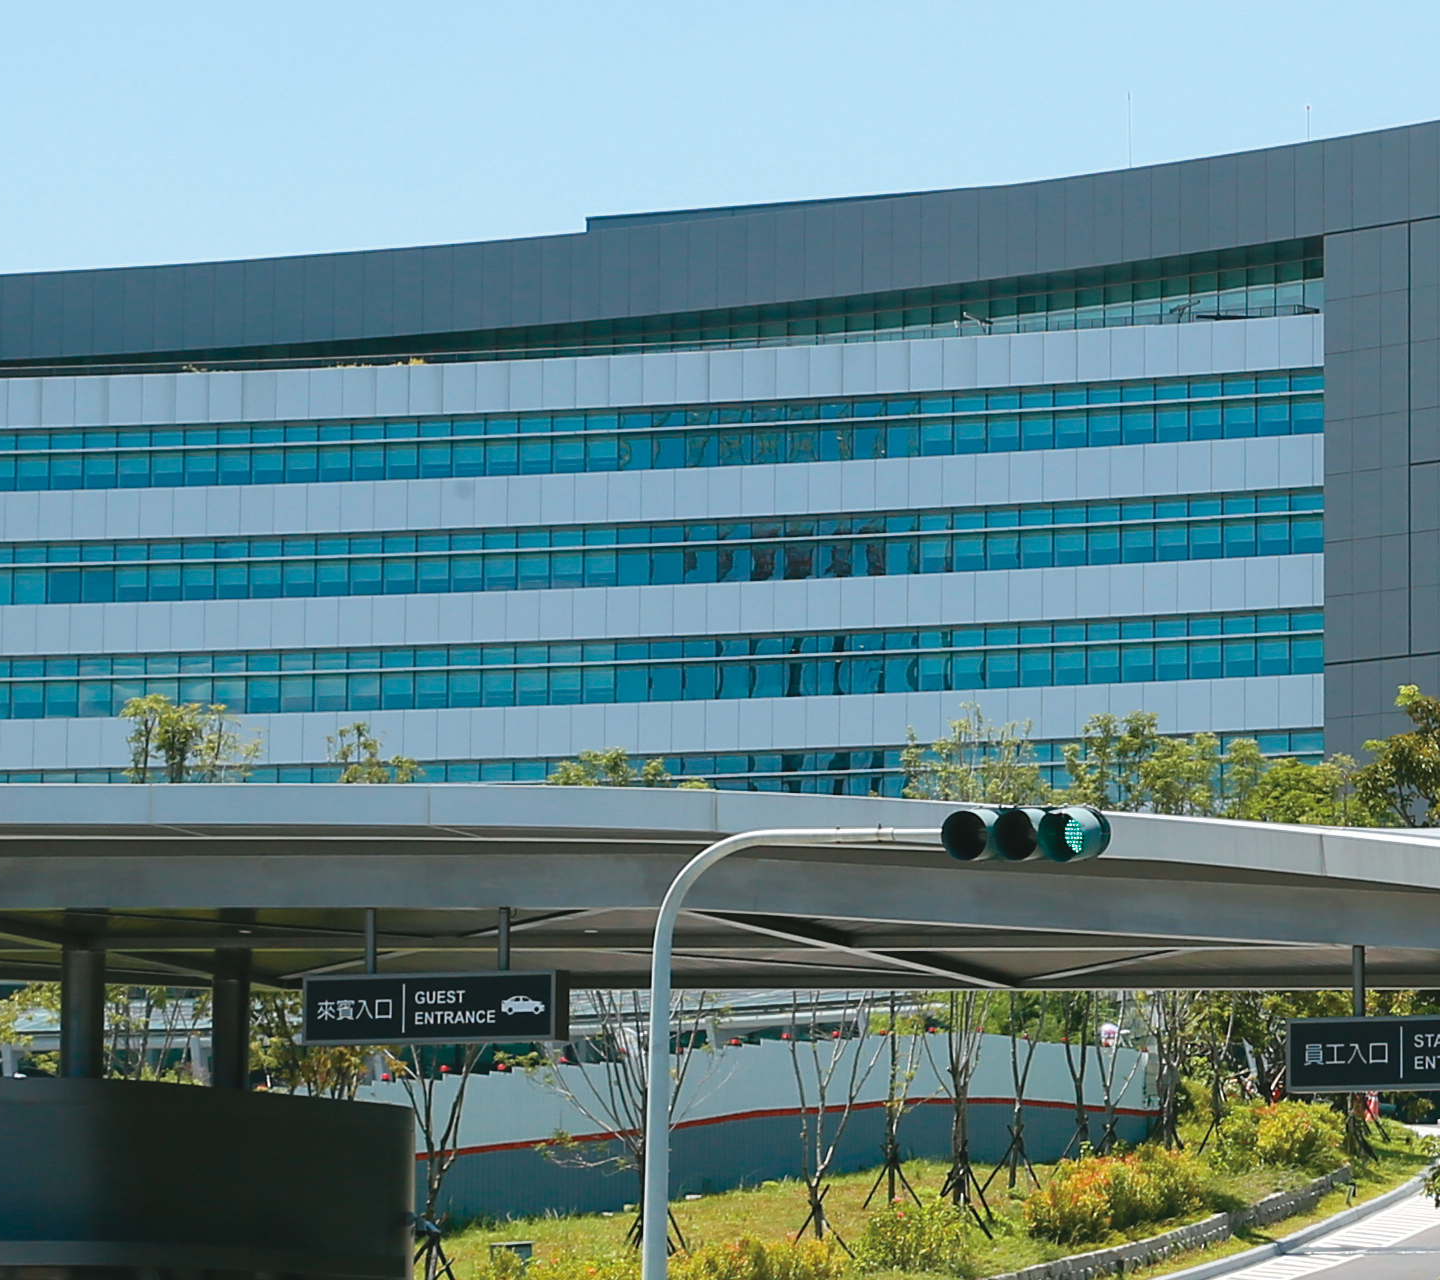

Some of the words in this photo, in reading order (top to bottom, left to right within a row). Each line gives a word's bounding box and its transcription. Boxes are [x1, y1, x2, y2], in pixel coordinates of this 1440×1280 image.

[414, 989, 466, 1005] GUEST
[316, 998, 393, 1021] 來賓入口
[414, 1009, 496, 1026] ENTRANCE
[1304, 1042, 1389, 1066] 員工入口
